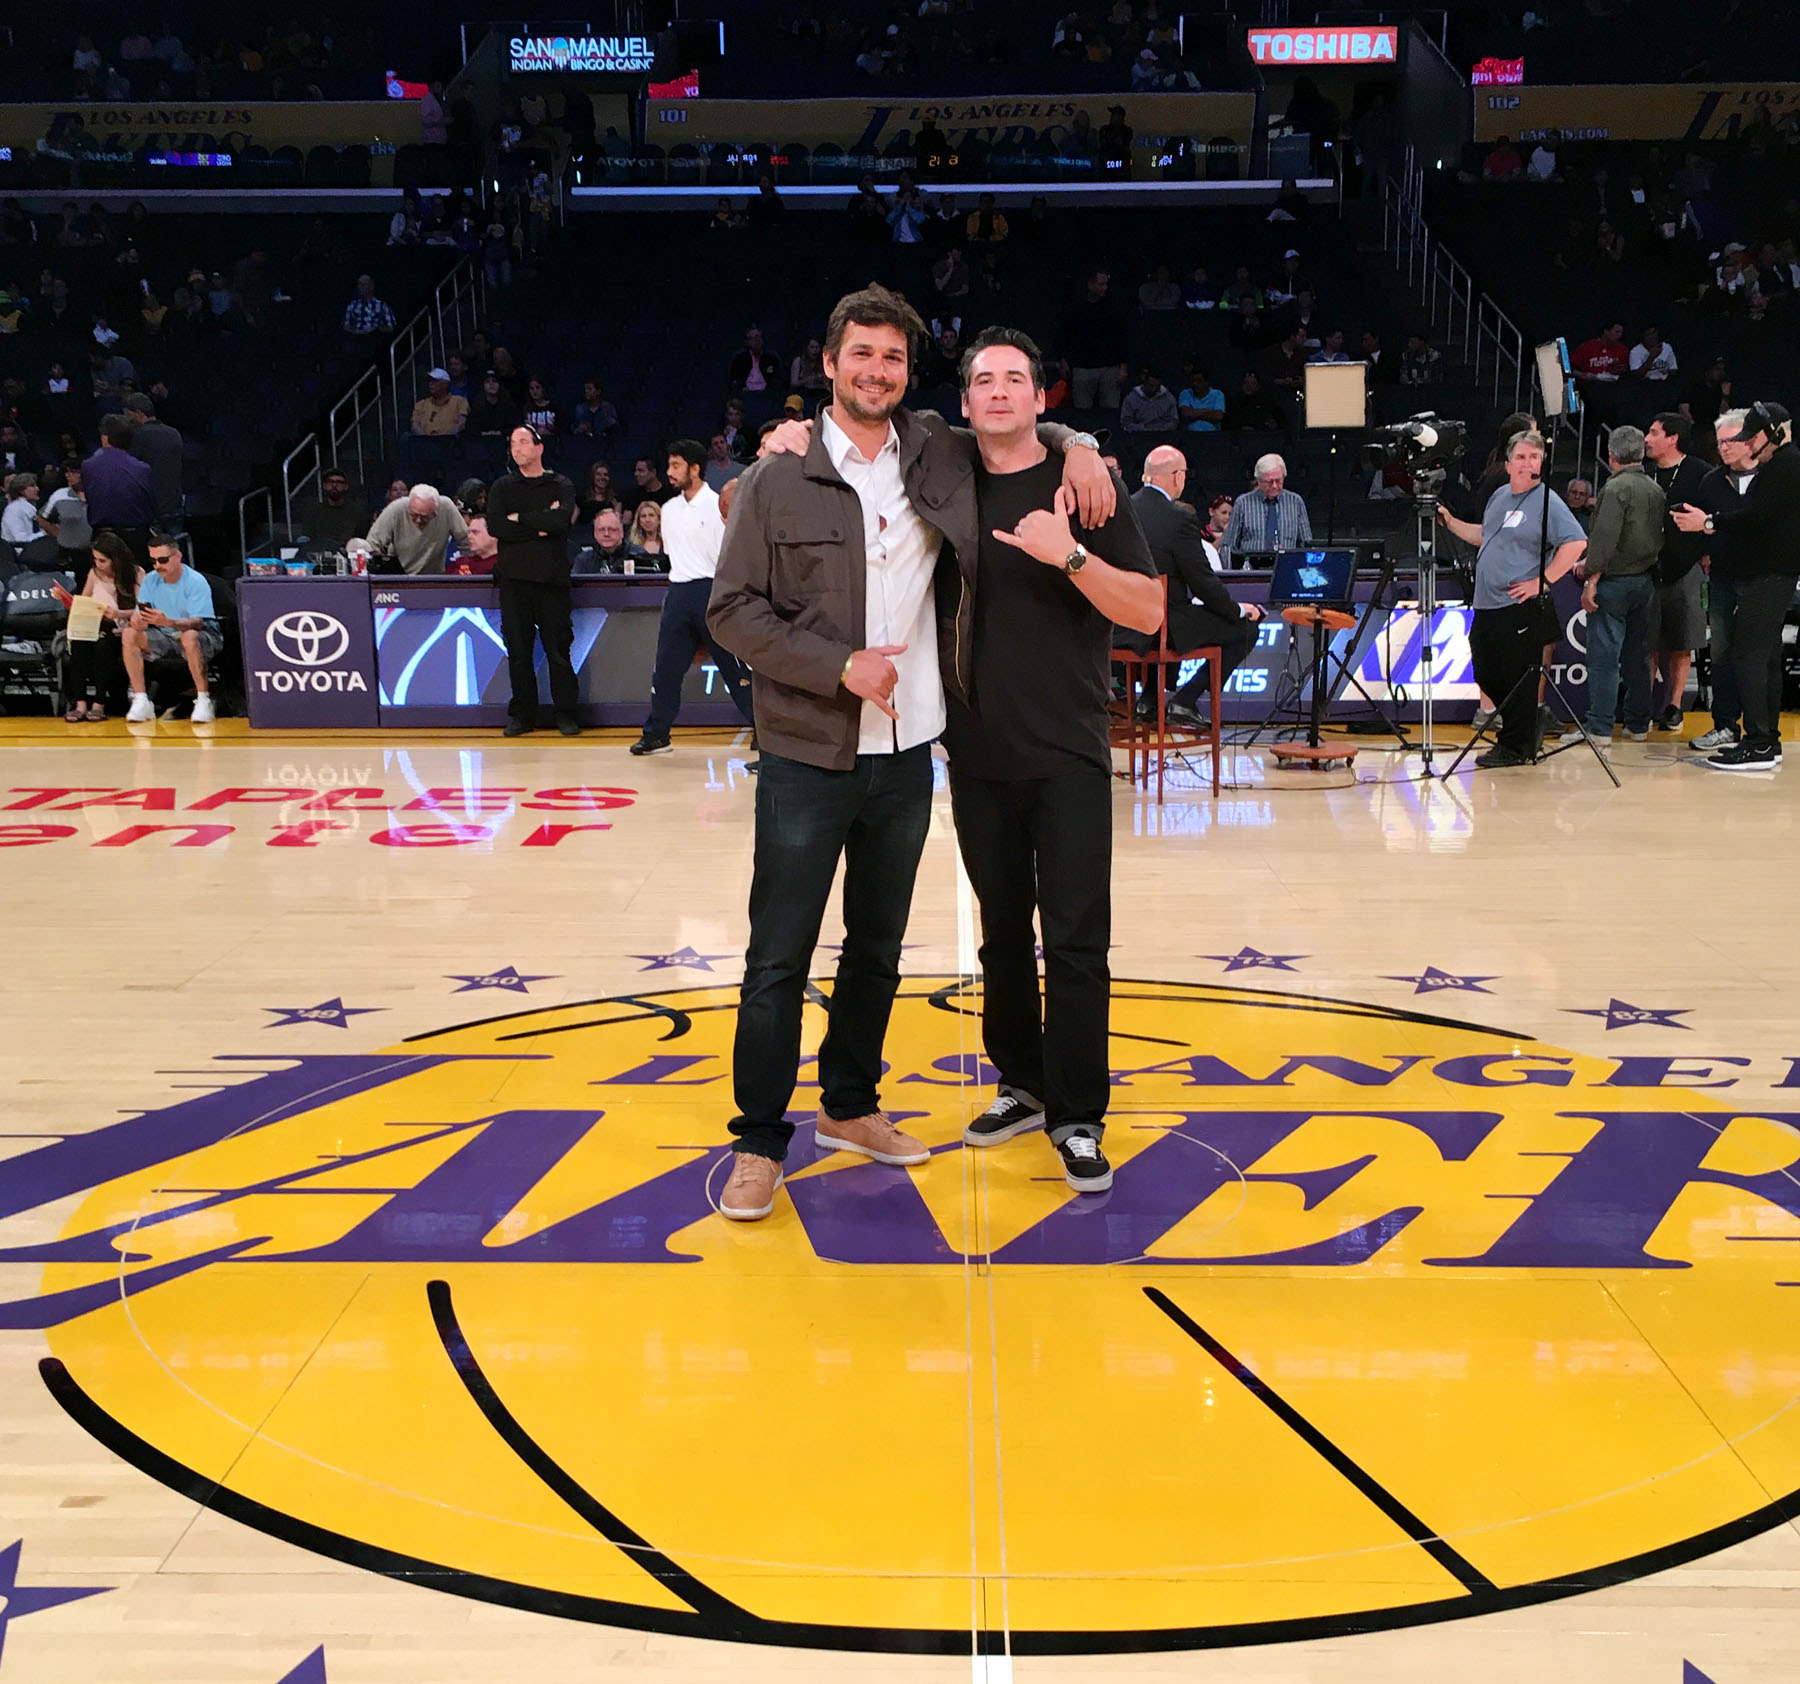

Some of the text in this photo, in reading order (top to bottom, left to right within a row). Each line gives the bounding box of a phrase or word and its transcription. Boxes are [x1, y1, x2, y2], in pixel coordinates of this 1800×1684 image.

[510, 36, 655, 58] SAN MANUEL
[1251, 33, 1394, 60] TOSHIBA
[511, 58, 553, 71] INDIAN
[1488, 96, 1520, 109] 102
[658, 108, 687, 122] 101
[957, 102, 1078, 119] ANGELES
[374, 592, 400, 604] ANC
[254, 671, 368, 692] TOYOTA
